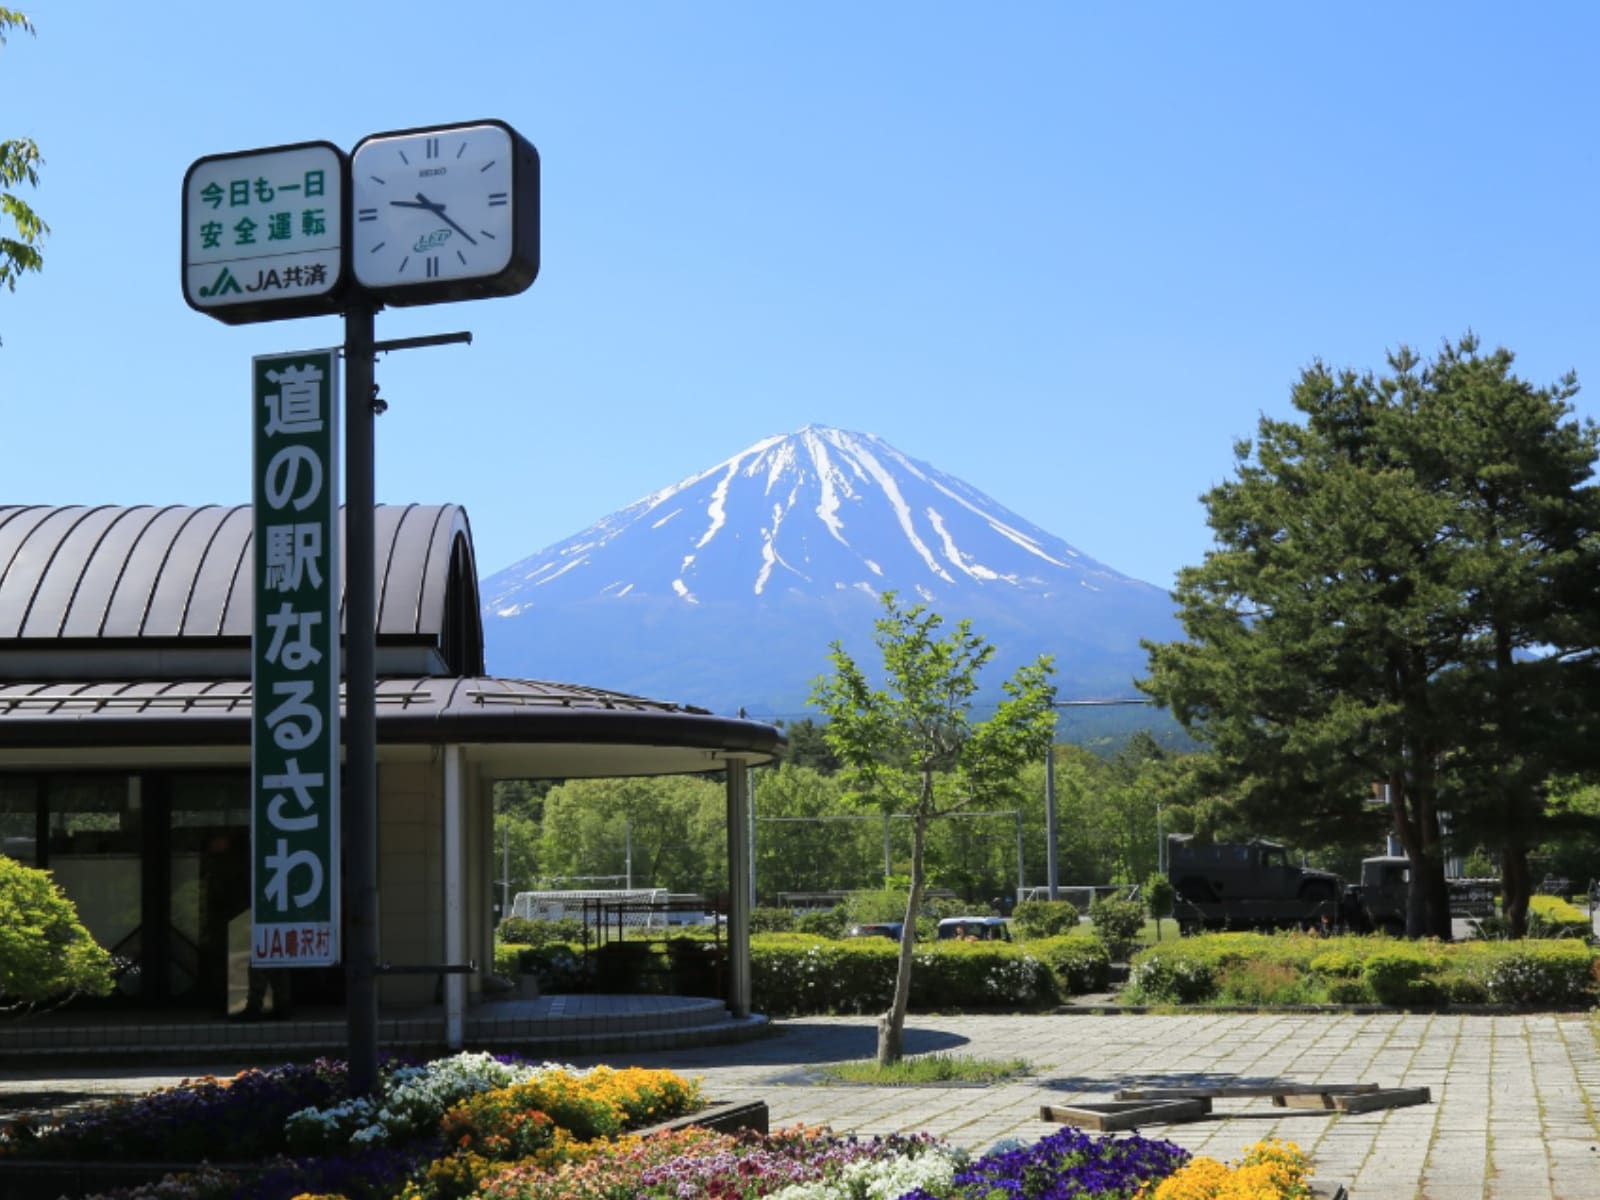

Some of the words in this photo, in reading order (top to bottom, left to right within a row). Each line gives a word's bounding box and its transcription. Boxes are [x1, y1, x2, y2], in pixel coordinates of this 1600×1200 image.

[200, 169, 325, 210] 今日も一日
[200, 208, 326, 249] 安全運転
[245, 263, 328, 293] JA共済
[263, 363, 324, 912] 道の駅なるさわ
